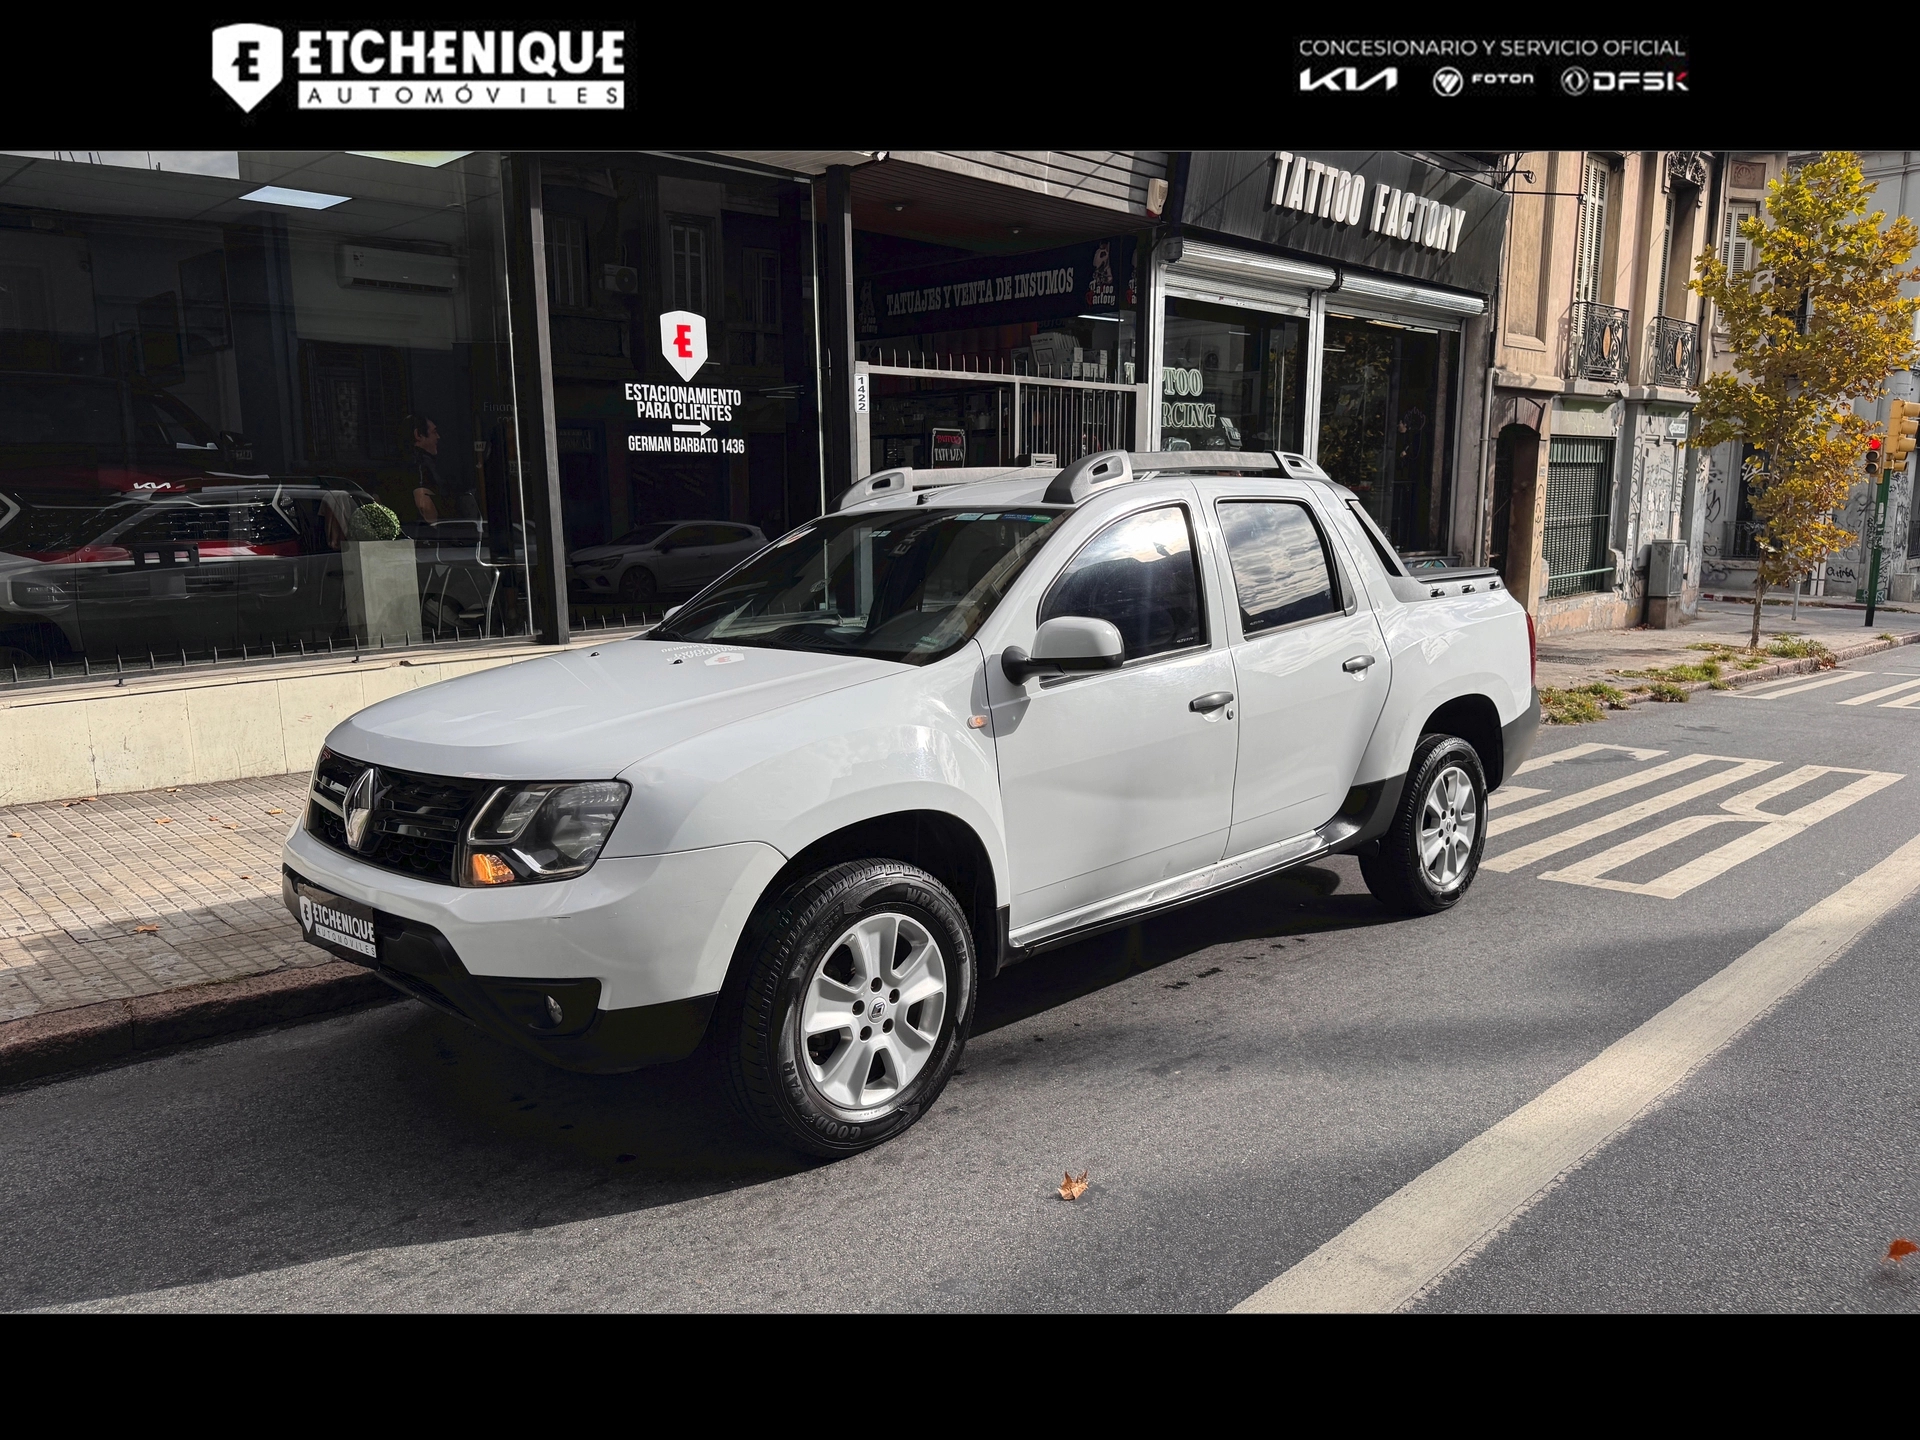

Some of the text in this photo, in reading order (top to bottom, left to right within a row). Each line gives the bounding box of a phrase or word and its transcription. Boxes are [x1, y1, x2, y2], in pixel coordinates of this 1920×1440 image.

[1271, 151, 1467, 254] TATTOO FACTORY
[886, 267, 1075, 316] TATUAJES Y VENTA DE INSUMOS
[624, 383, 742, 406] ESTACIONAMIENTO
[636, 401, 732, 421] PARA CLIENTES
[857, 376, 866, 411] 1422
[628, 435, 745, 454] GERMAN BARBATO 1436
[312, 902, 375, 943] ETCHENIQUE
[904, 885, 969, 964] WRANGLER
